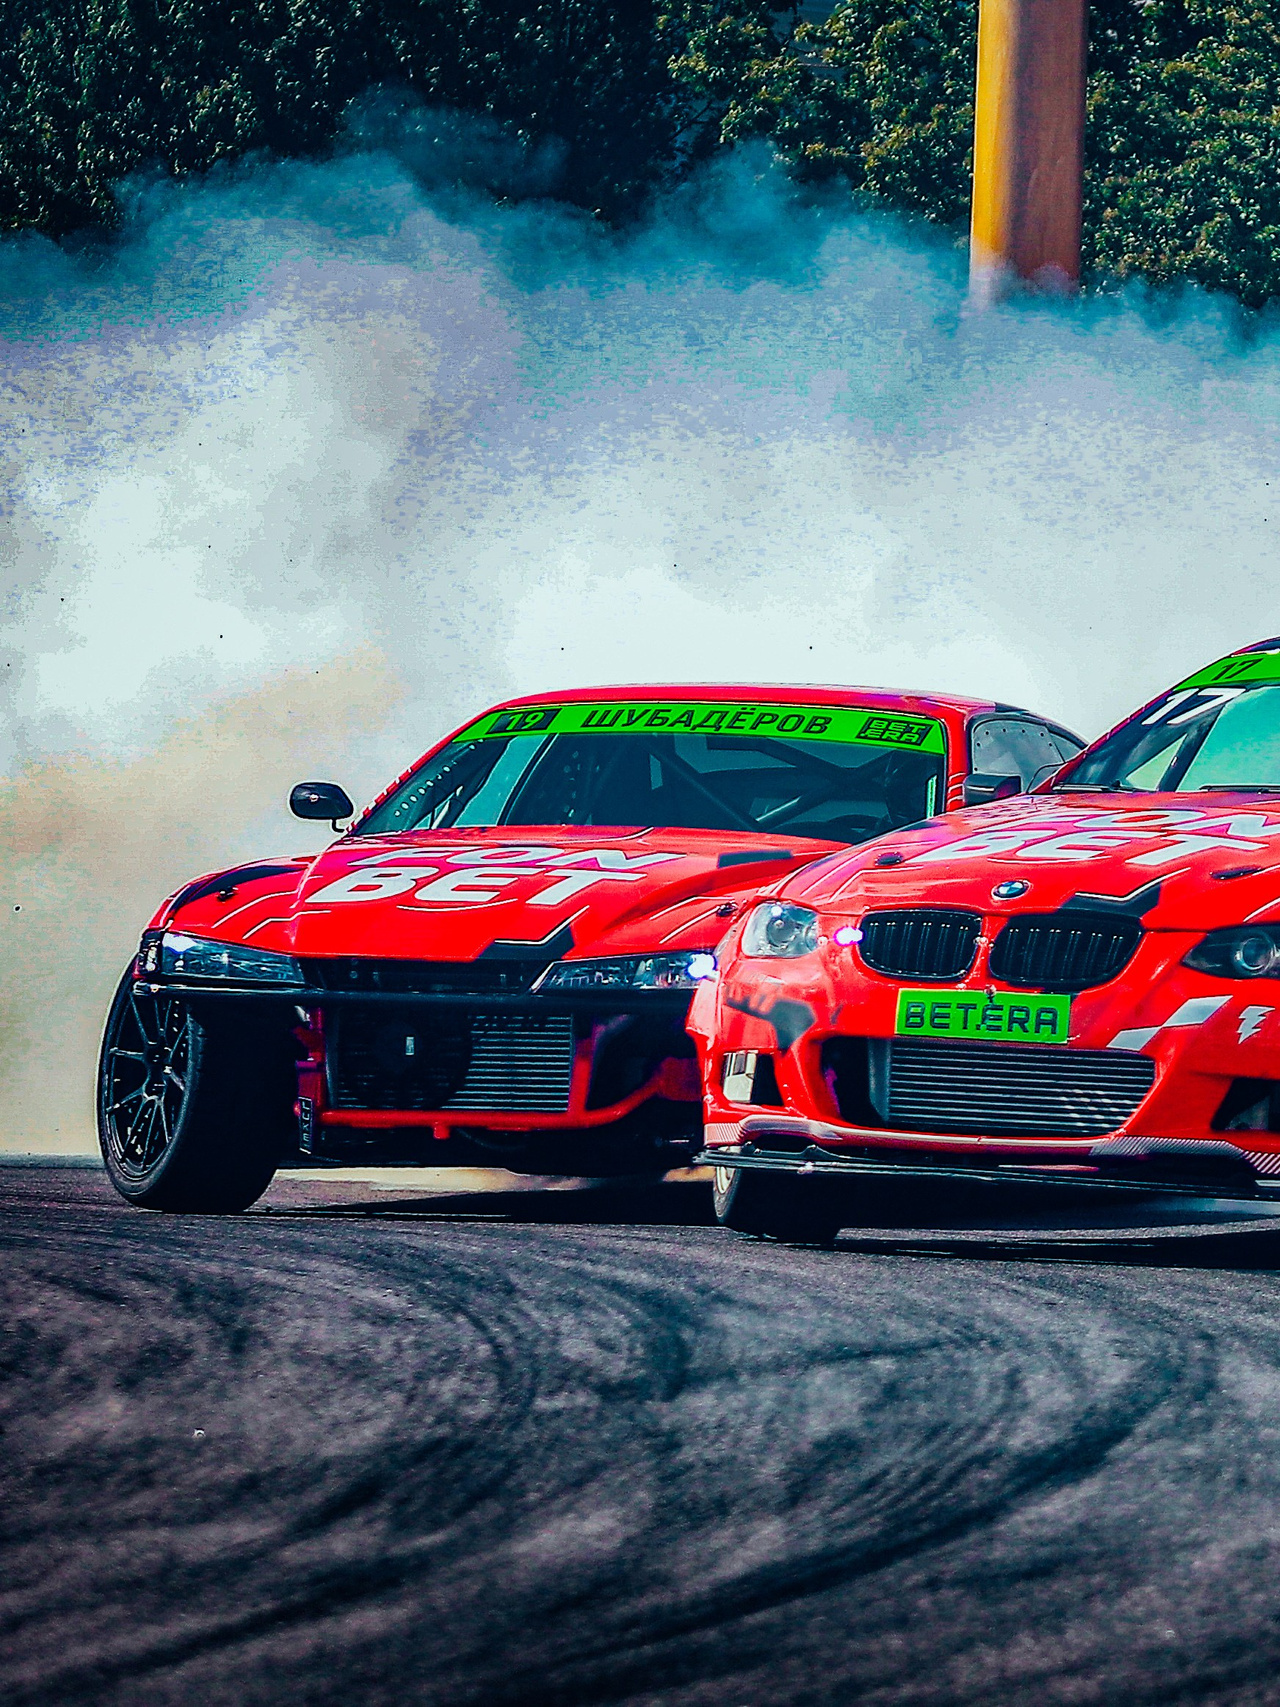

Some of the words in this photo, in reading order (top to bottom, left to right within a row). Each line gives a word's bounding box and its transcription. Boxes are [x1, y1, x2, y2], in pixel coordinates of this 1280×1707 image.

[1211, 657, 1264, 682] 17
[1141, 687, 1247, 726] 17
[505, 711, 546, 731] 19
[580, 706, 833, 734] ШУБАДЁРОВ
[869, 719, 927, 733] BET
[347, 846, 687, 869] FON
[906, 828, 1270, 866] BET
[305, 866, 649, 906] BET
